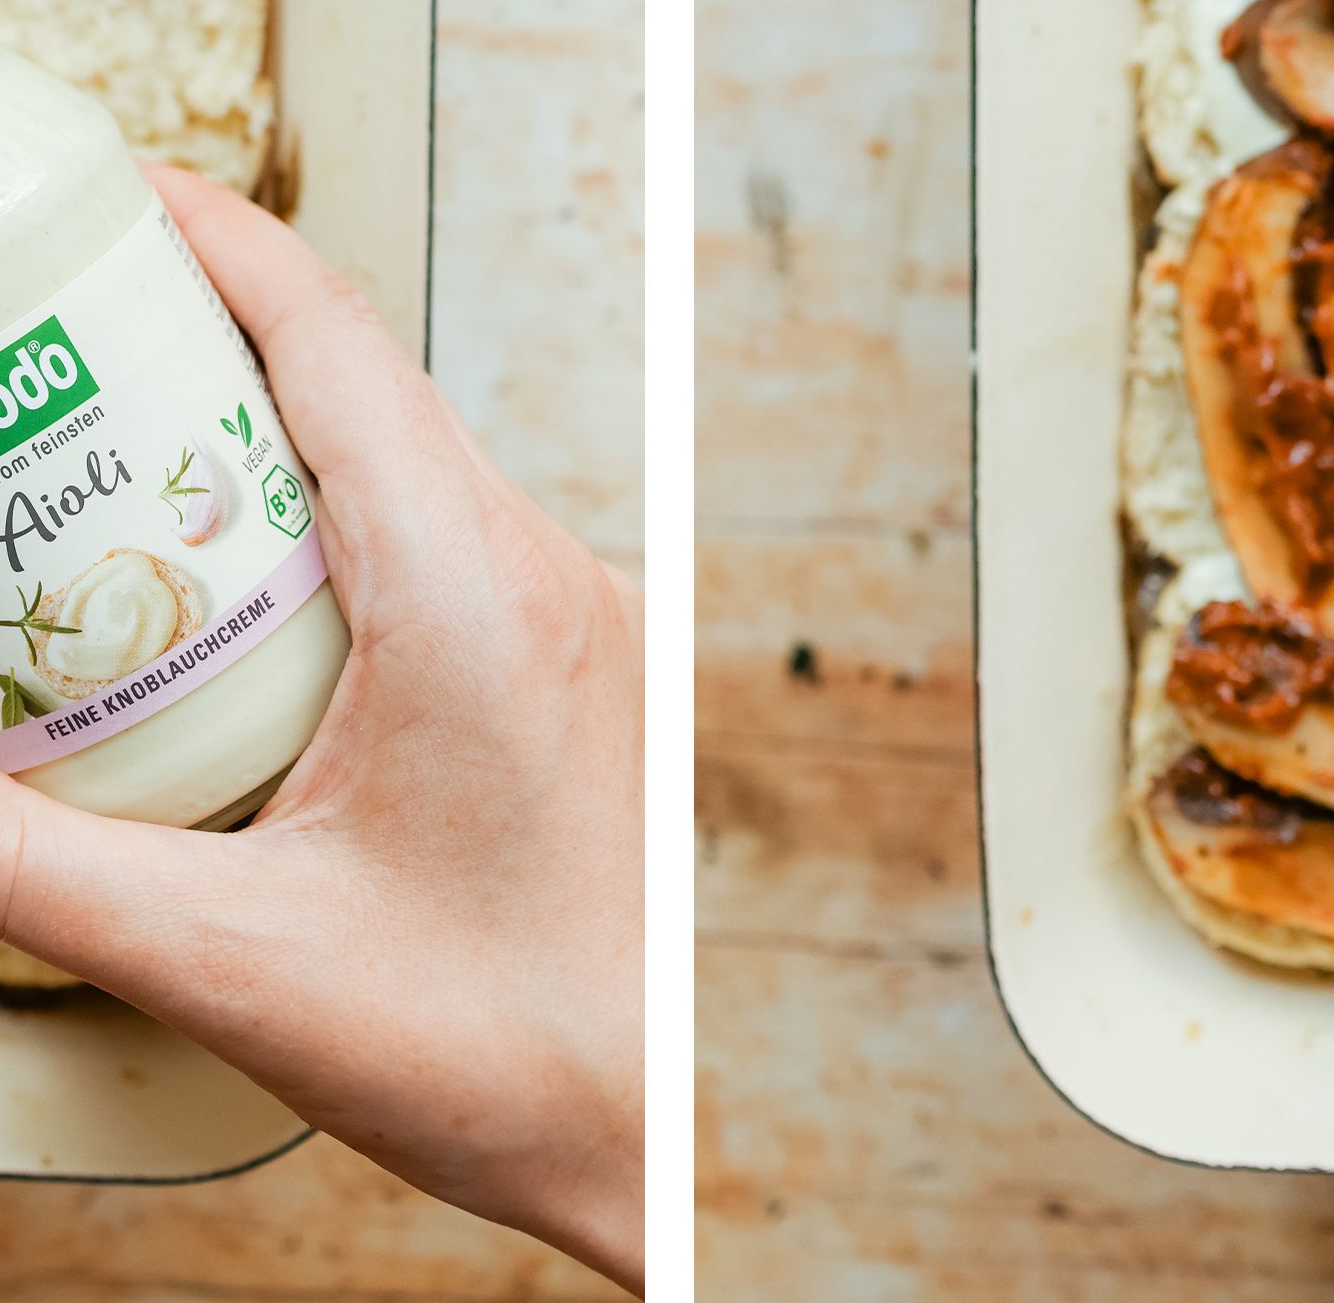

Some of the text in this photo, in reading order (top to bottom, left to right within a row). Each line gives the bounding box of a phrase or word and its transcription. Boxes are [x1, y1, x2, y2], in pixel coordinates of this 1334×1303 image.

[32, 405, 105, 460] feinsten
[242, 434, 273, 474] VEGAN
[44, 590, 276, 740] FEINE KNOBLAUCHCREME
